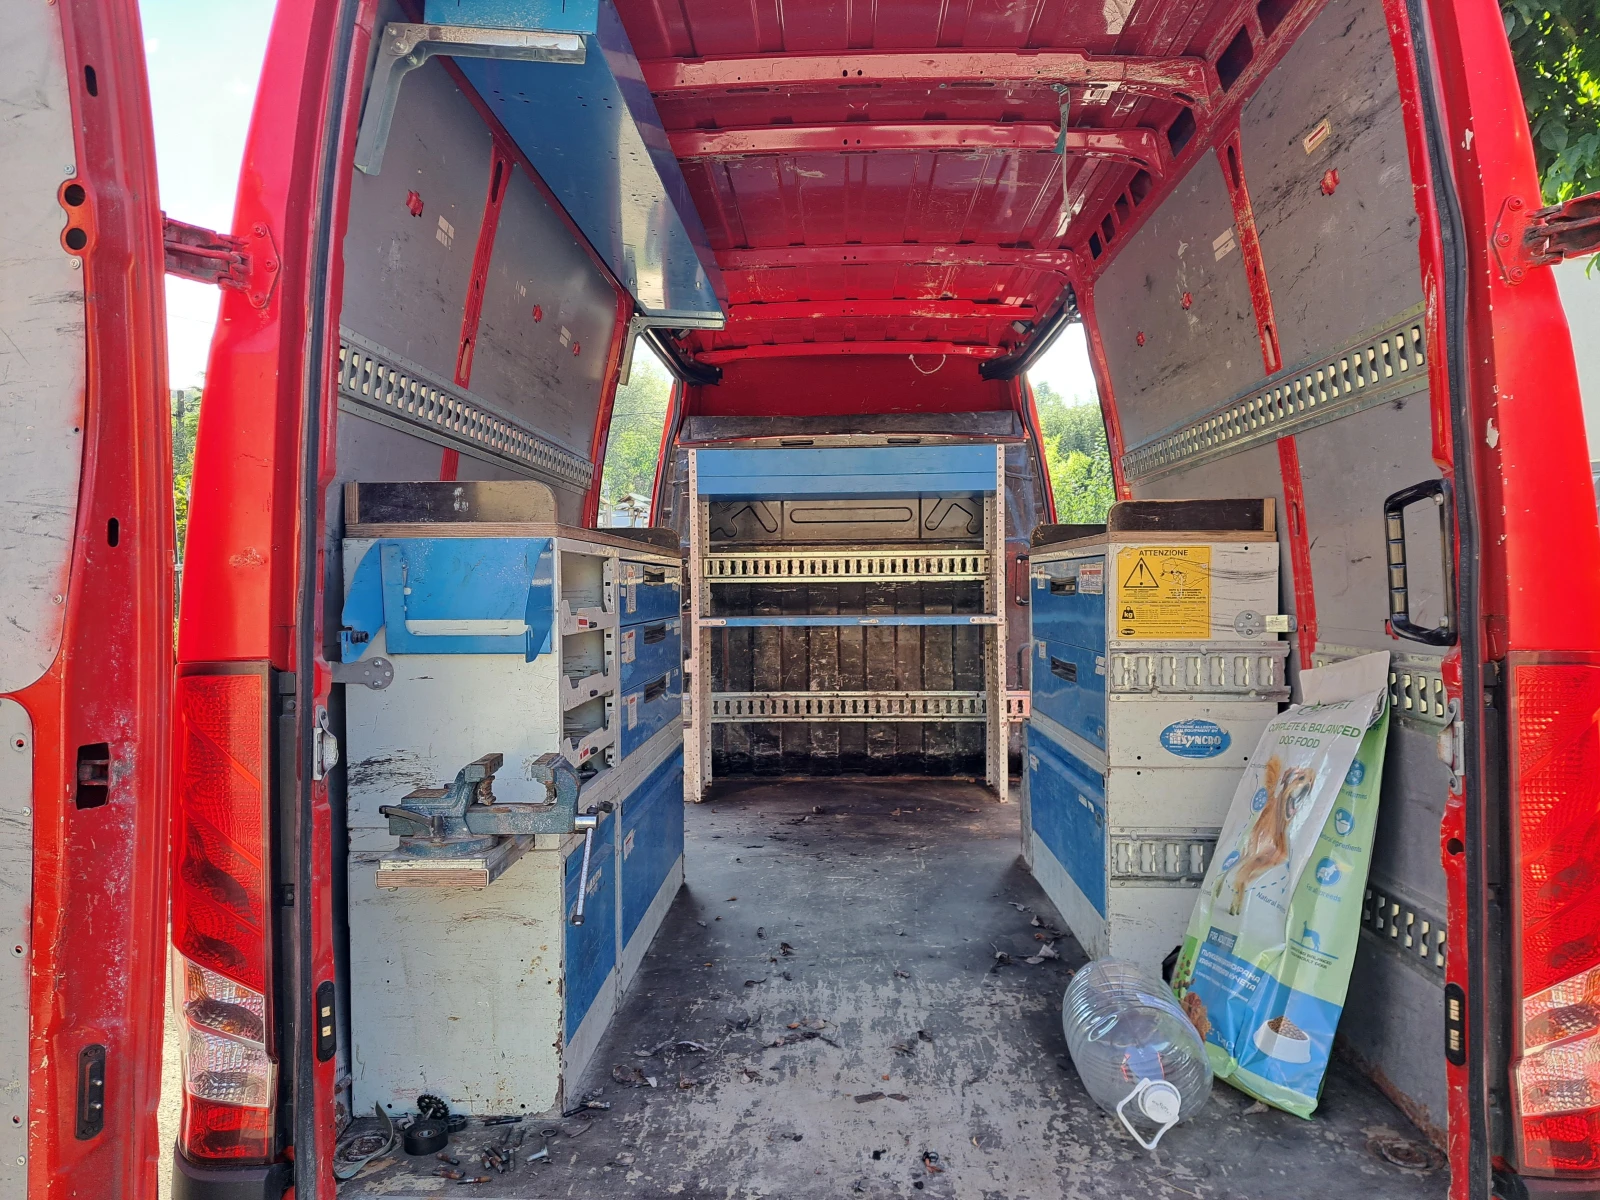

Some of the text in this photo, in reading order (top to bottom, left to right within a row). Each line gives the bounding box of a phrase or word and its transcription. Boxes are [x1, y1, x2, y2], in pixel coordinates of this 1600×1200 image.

[1138, 549, 1189, 557] ATTENZIONE
[1123, 611, 1133, 619] kg
[1268, 722, 1301, 732] COMPLETE
[1301, 722, 1308, 732] &
[1308, 722, 1361, 738] BALANCED
[1278, 735, 1320, 748] DOG FOOD
[1255, 891, 1277, 907] Natural
